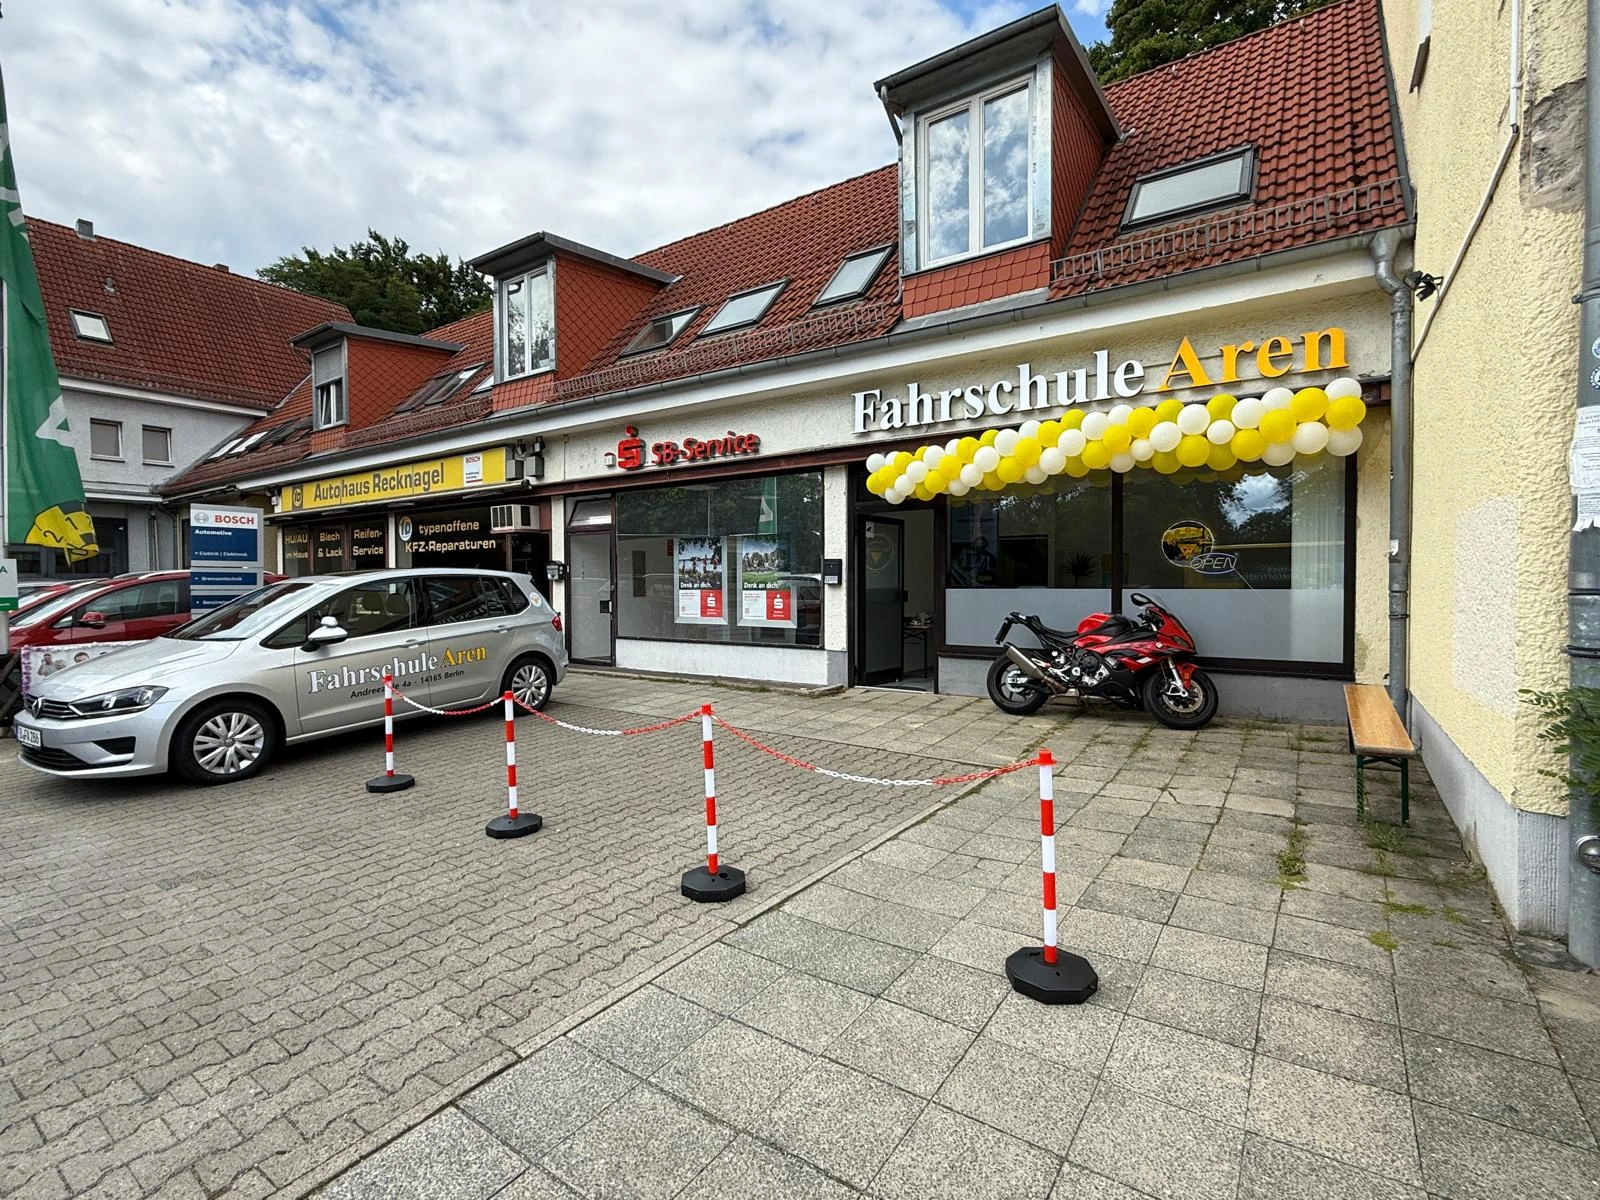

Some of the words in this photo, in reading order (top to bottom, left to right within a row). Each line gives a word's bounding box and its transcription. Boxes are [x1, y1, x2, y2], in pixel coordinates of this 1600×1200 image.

[851, 349, 1145, 434] Fahrschule
[1157, 327, 1349, 392] Aren
[651, 431, 760, 464] SB-Service
[466, 456, 480, 464] BOSCH
[313, 480, 370, 502] Autohaus
[372, 462, 444, 493] Recknagel
[214, 514, 255, 525] BOSCH
[354, 528, 382, 539] Reifen-
[418, 520, 480, 536] typenoffene
[319, 532, 340, 542] Blech
[325, 548, 343, 557] Lack
[352, 545, 384, 556] Service
[405, 539, 496, 553] KFZ-Reparaturen
[1190, 556, 1237, 569] OPEN
[308, 652, 438, 694] Fahrschule
[440, 646, 487, 668] Aren
[421, 674, 442, 684] 14165
[444, 669, 464, 679] Berlin
